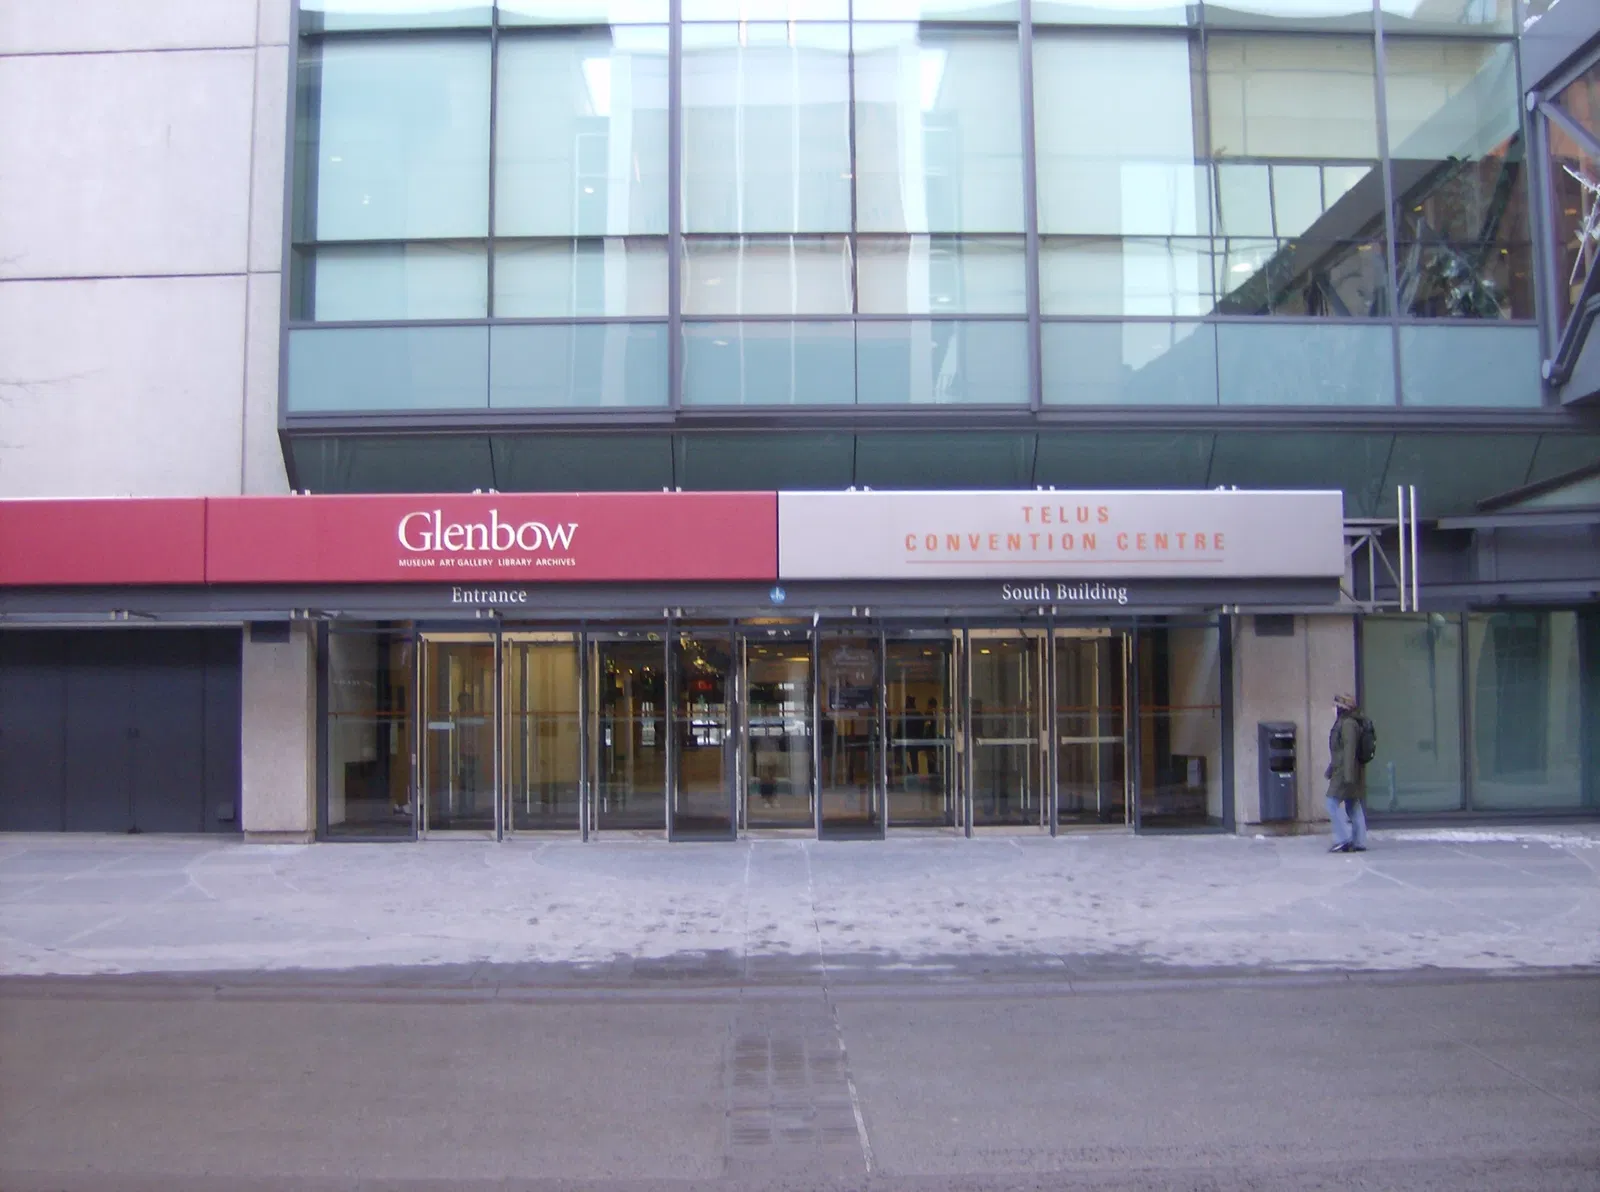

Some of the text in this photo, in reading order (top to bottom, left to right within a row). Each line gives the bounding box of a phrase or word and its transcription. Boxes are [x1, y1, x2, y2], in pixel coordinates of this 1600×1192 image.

[1022, 505, 1110, 524] TELUS
[398, 508, 579, 552] Glenbow
[904, 532, 1226, 552] CONVENTION CENTRE
[398, 558, 576, 567] MUSEUM ART GALLERY LIBRARY ARCHIVES
[452, 586, 528, 603] Entrance
[1002, 583, 1128, 604] South Building
